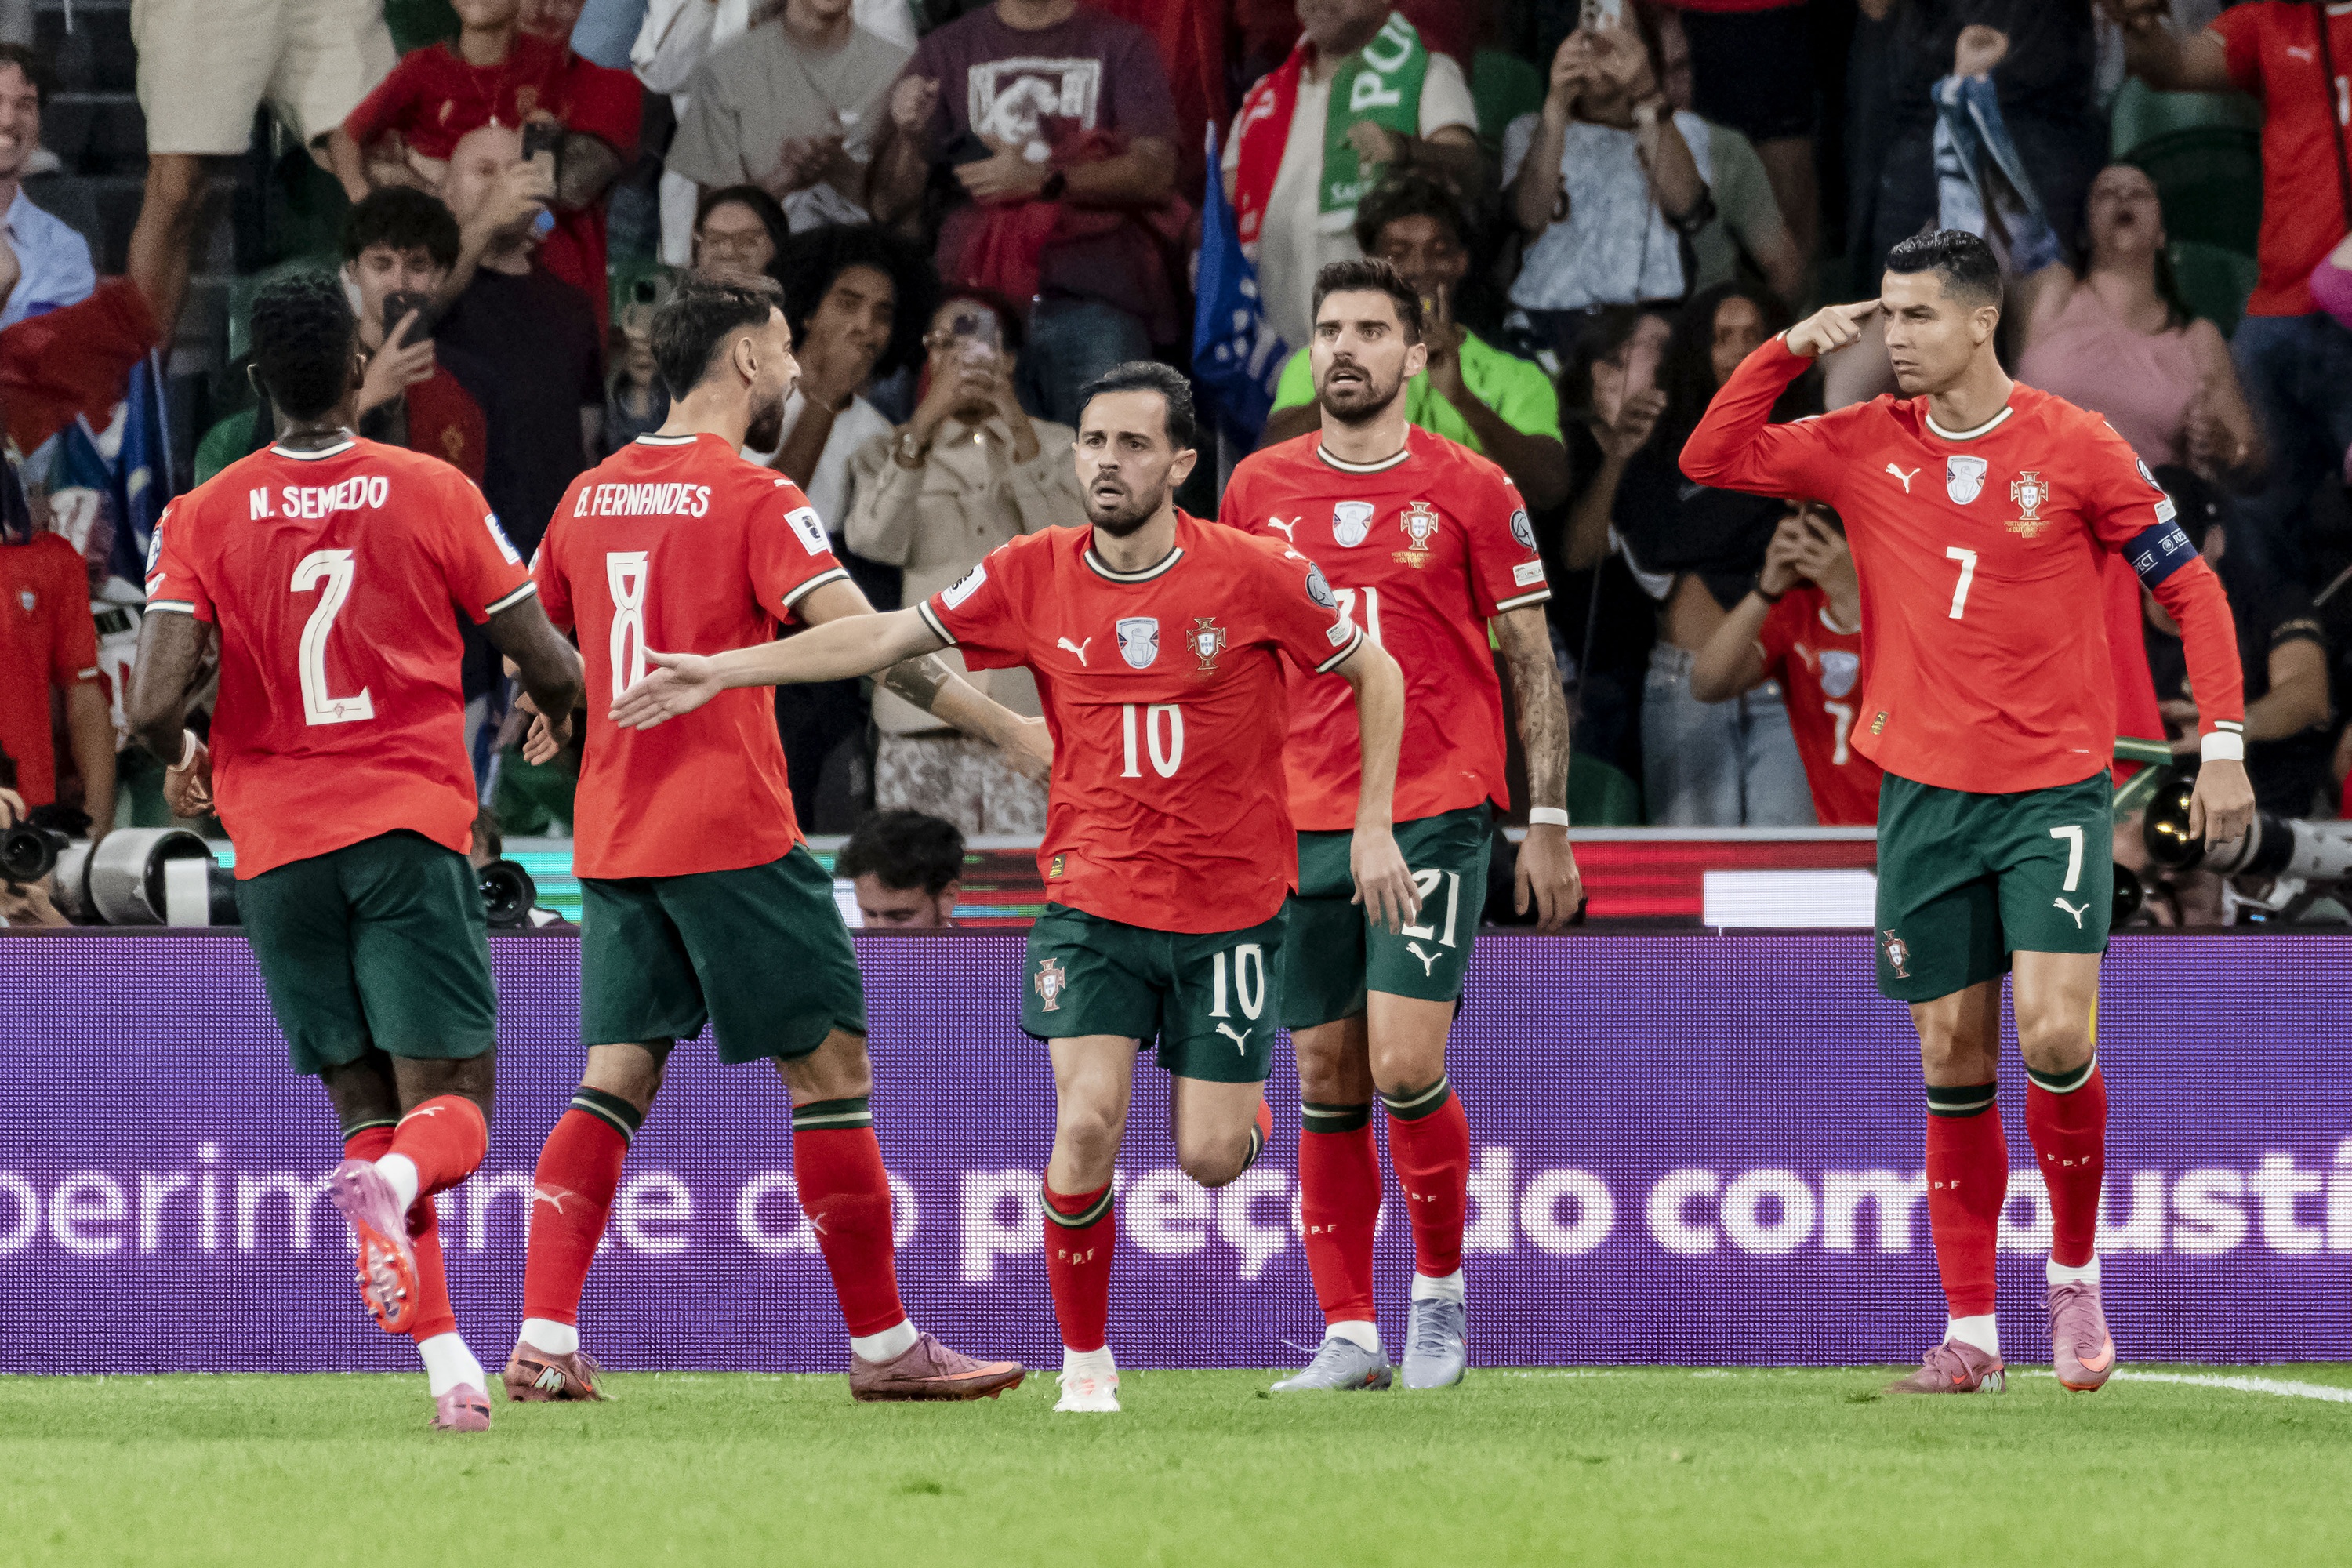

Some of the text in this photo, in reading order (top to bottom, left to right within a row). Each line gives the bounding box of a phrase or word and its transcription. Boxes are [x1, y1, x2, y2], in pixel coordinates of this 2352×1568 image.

[249, 476, 388, 521] N. SEMEDO
[573, 483, 710, 517] B. FERNANDES
[1946, 546, 1977, 619] 7
[291, 549, 373, 725] 2
[606, 551, 649, 701] 8
[1120, 703, 1185, 779] 10
[1824, 700, 1853, 765] 7
[2049, 826, 2083, 891] 7
[1401, 868, 1459, 948] 21
[1208, 943, 1265, 1021] 10
